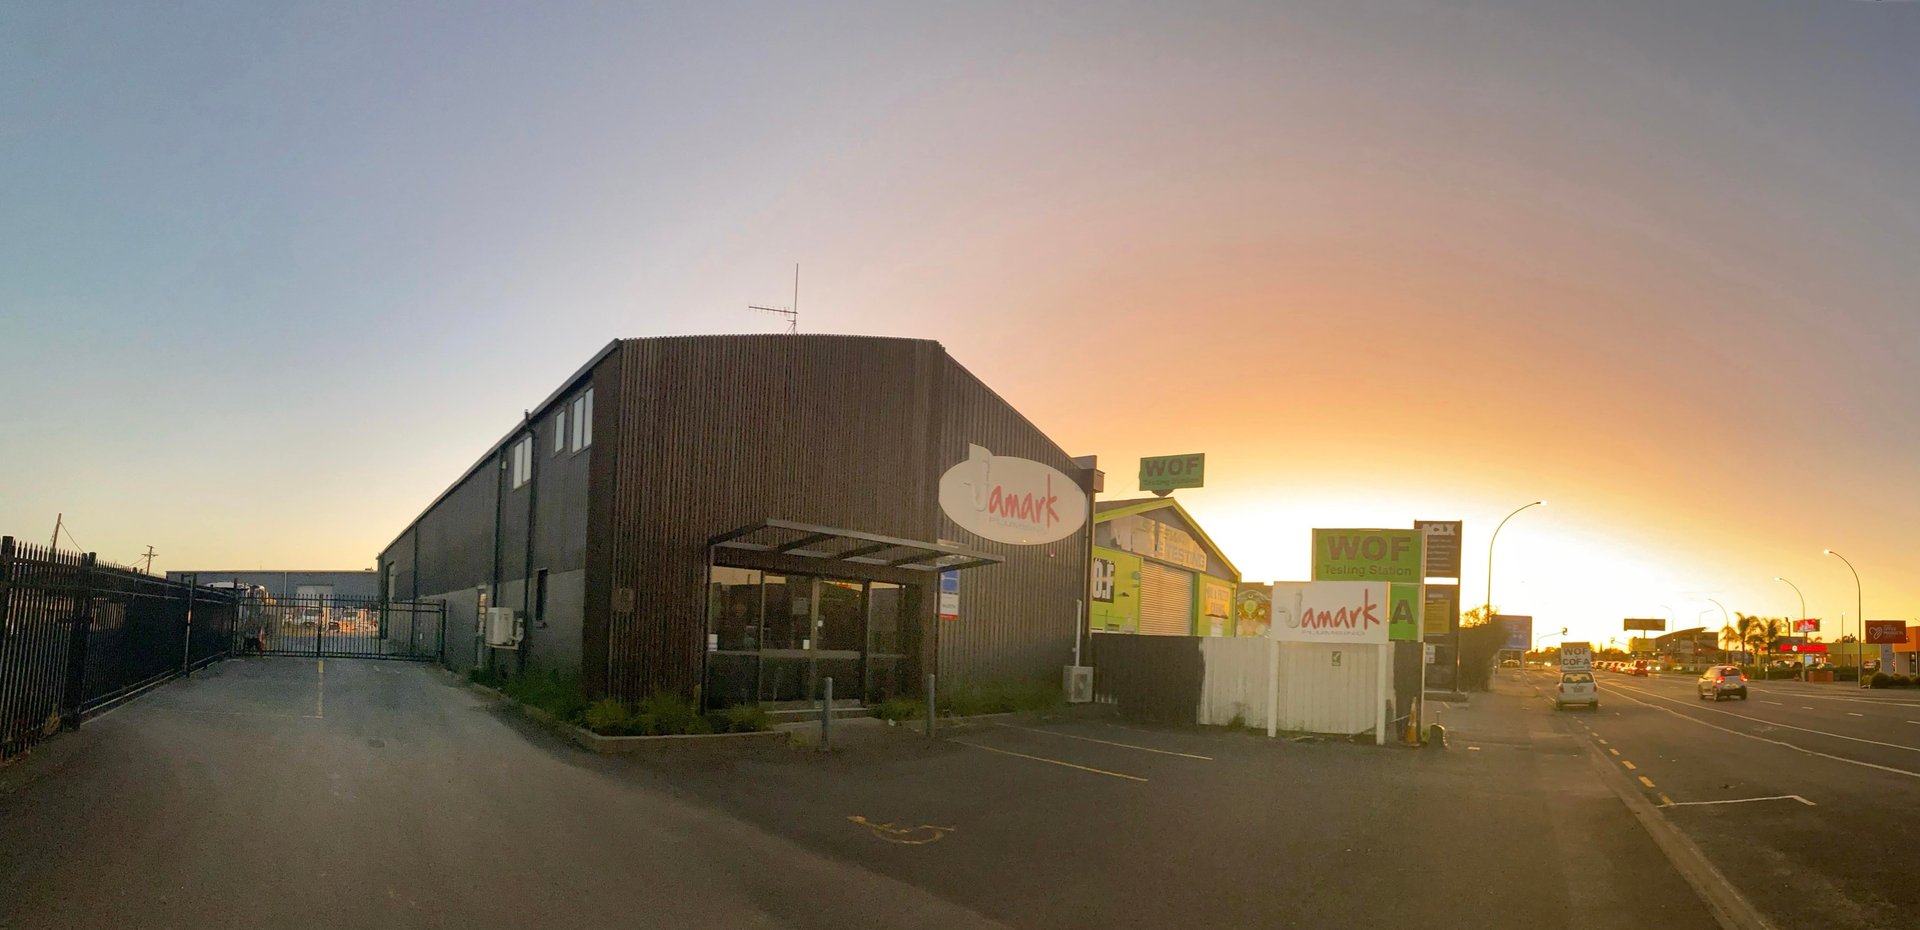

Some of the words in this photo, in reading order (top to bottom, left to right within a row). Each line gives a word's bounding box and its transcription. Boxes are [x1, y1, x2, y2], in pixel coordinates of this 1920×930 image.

[1144, 456, 1200, 477] WOF
[964, 459, 1060, 529] Jamark
[1327, 535, 1411, 562] WOF
[1324, 564, 1365, 577] Testing
[1369, 564, 1412, 576] Station
[1278, 588, 1380, 631] Jamark
[1563, 647, 1588, 656] WOF
